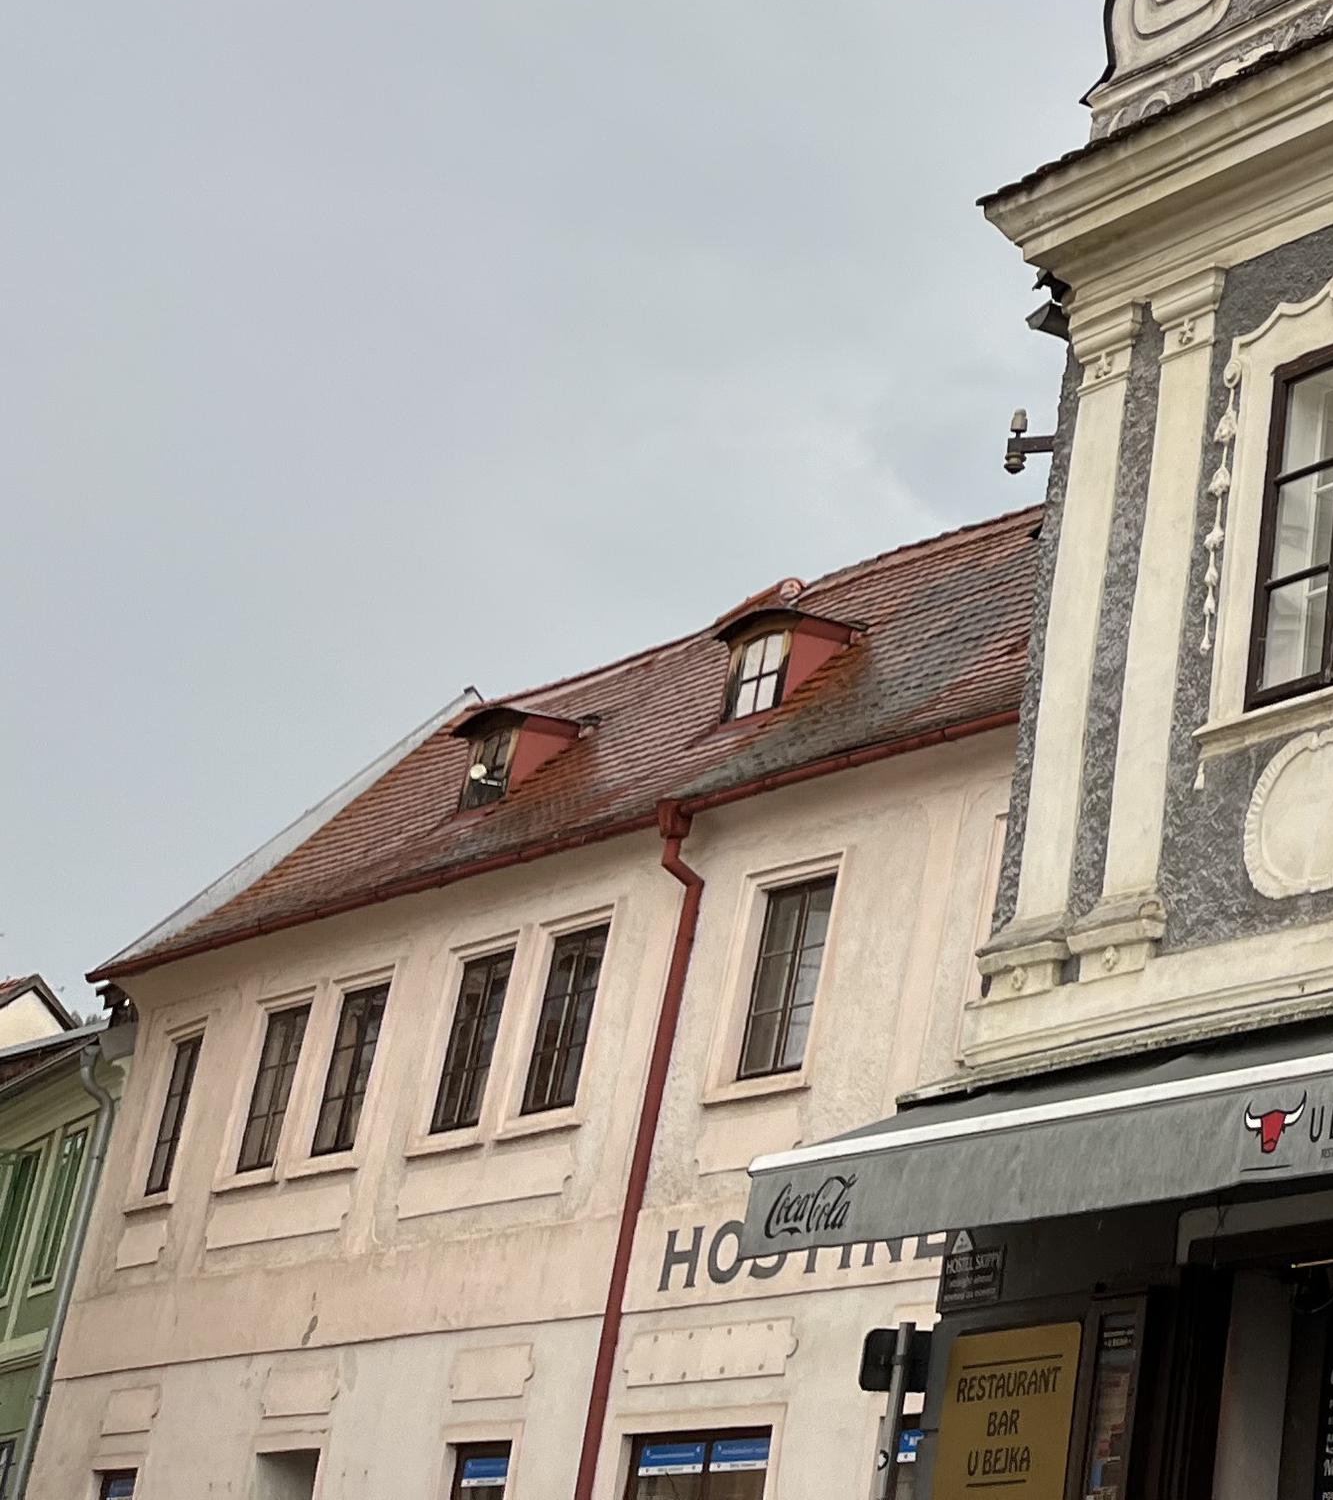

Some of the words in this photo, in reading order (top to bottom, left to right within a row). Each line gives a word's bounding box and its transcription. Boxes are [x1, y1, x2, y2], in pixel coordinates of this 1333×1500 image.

[1309, 1105, 1325, 1143] U
[764, 1173, 858, 1239] Coca-Cola
[956, 1366, 1062, 1403] RESTAURANT
[986, 1408, 1020, 1437] BAR
[967, 1449, 980, 1477] U
[982, 1446, 1032, 1476] BEJKA
